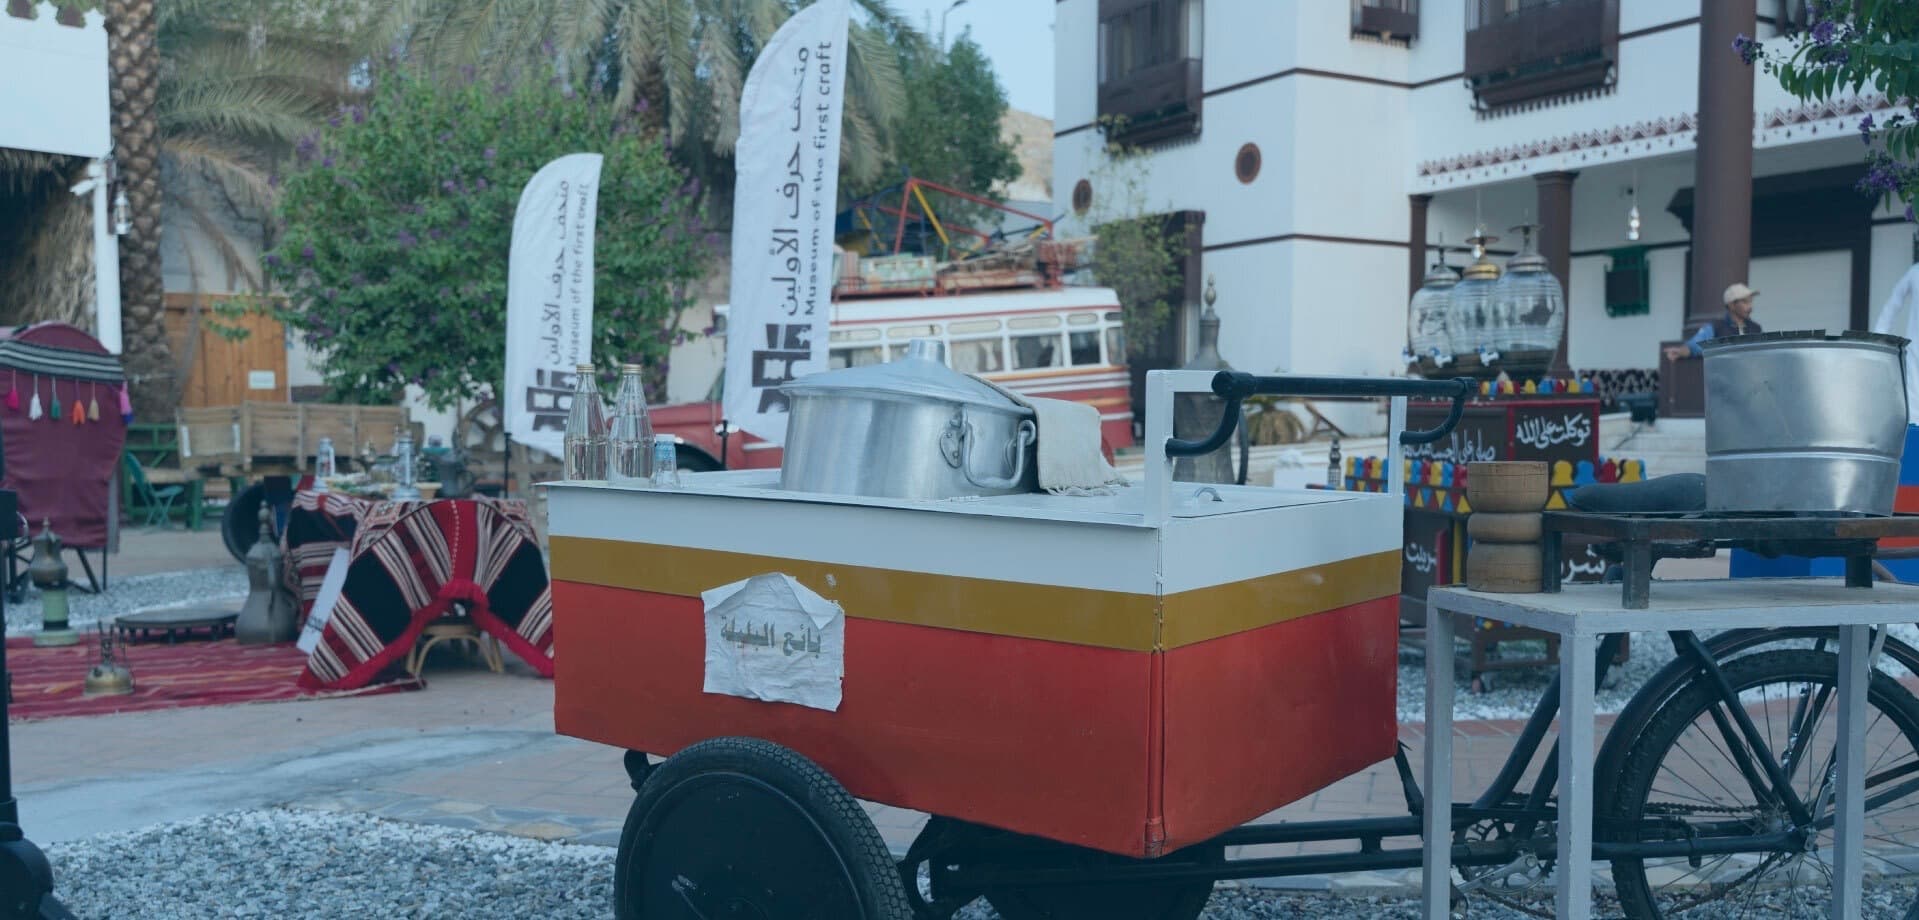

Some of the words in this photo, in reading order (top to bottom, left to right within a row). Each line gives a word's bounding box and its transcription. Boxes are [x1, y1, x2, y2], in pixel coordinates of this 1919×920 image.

[815, 41, 832, 95] craft
[814, 103, 829, 149] first
[776, 142, 804, 220] حرف
[813, 157, 824, 193] the
[576, 183, 590, 219] craft
[811, 200, 822, 221] of
[573, 224, 586, 255] first
[547, 247, 566, 299] حرف
[571, 260, 583, 284] the
[769, 228, 801, 316] الأولين
[804, 228, 820, 316] Museum
[570, 288, 582, 304] of
[567, 307, 581, 367] Museum
[1516, 415, 1538, 444] الله
[1535, 416, 1557, 449] على
[1551, 413, 1591, 447] توكلت
[720, 616, 776, 652] البليلة
